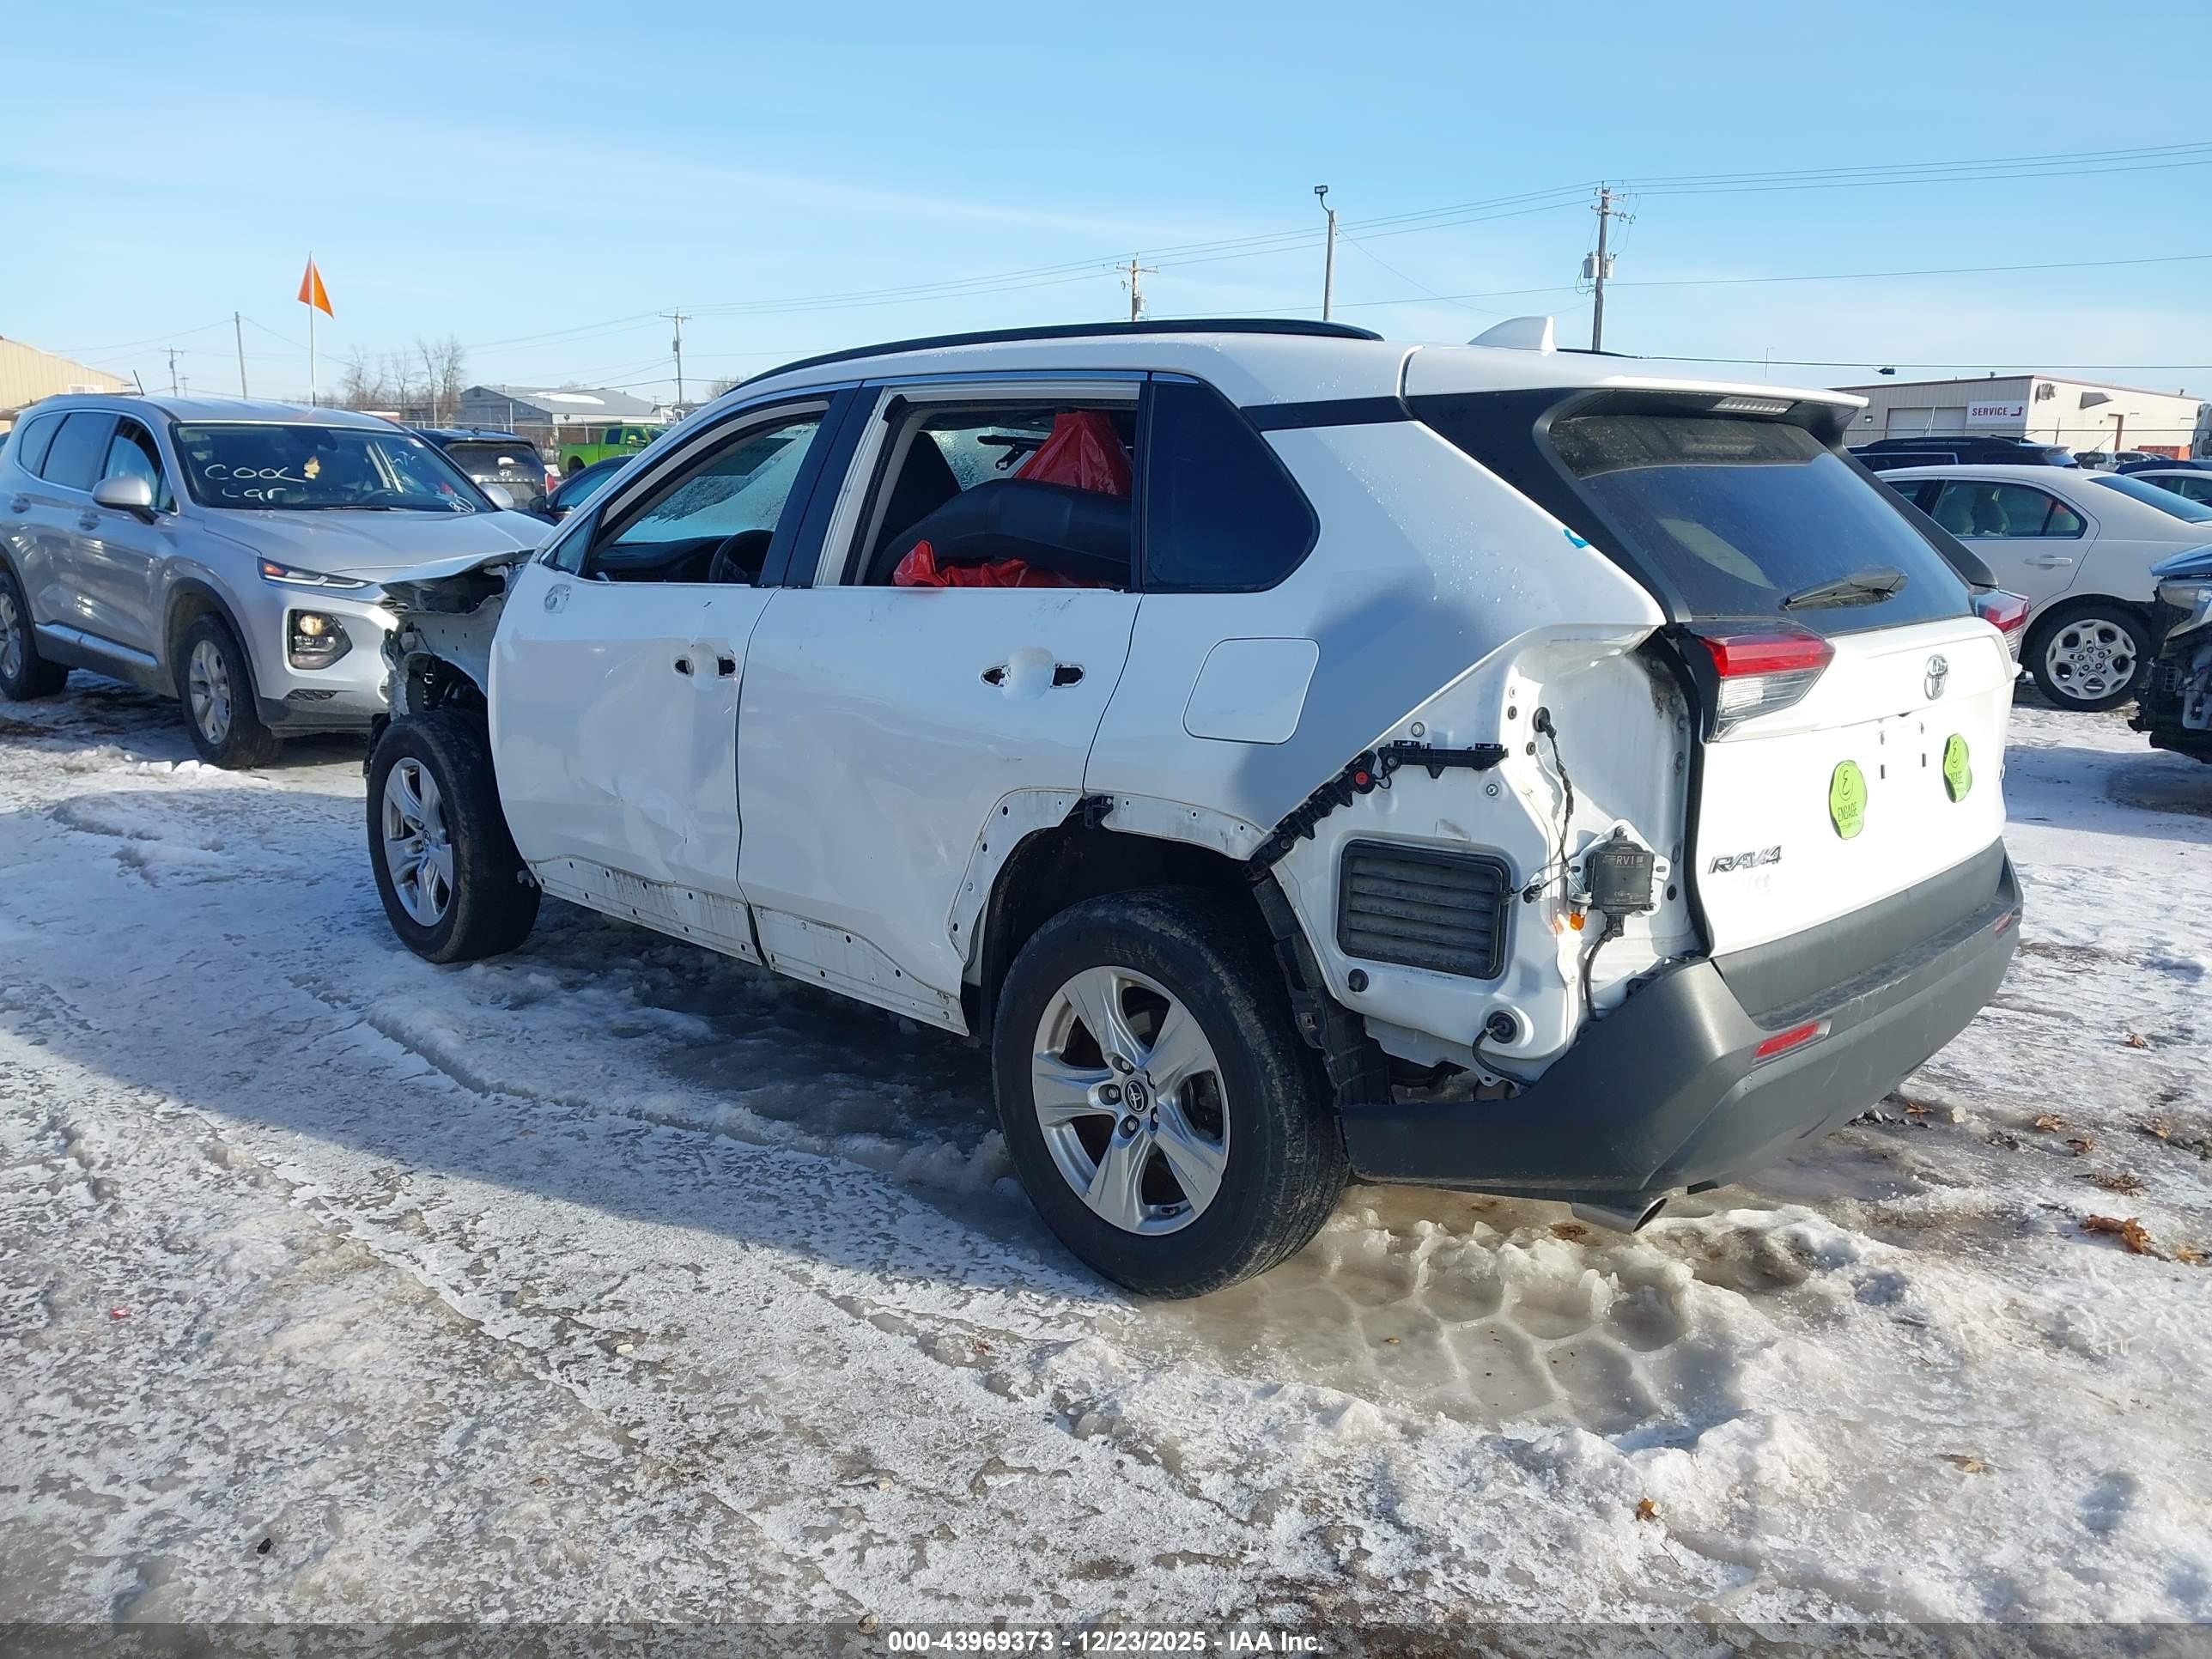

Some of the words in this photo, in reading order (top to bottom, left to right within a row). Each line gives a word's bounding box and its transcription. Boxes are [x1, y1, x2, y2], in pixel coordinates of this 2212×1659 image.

[1972, 406, 2008, 416] SERVICE
[1838, 801, 1858, 823] ENGAGE
[1707, 844, 1782, 874] RAV4
